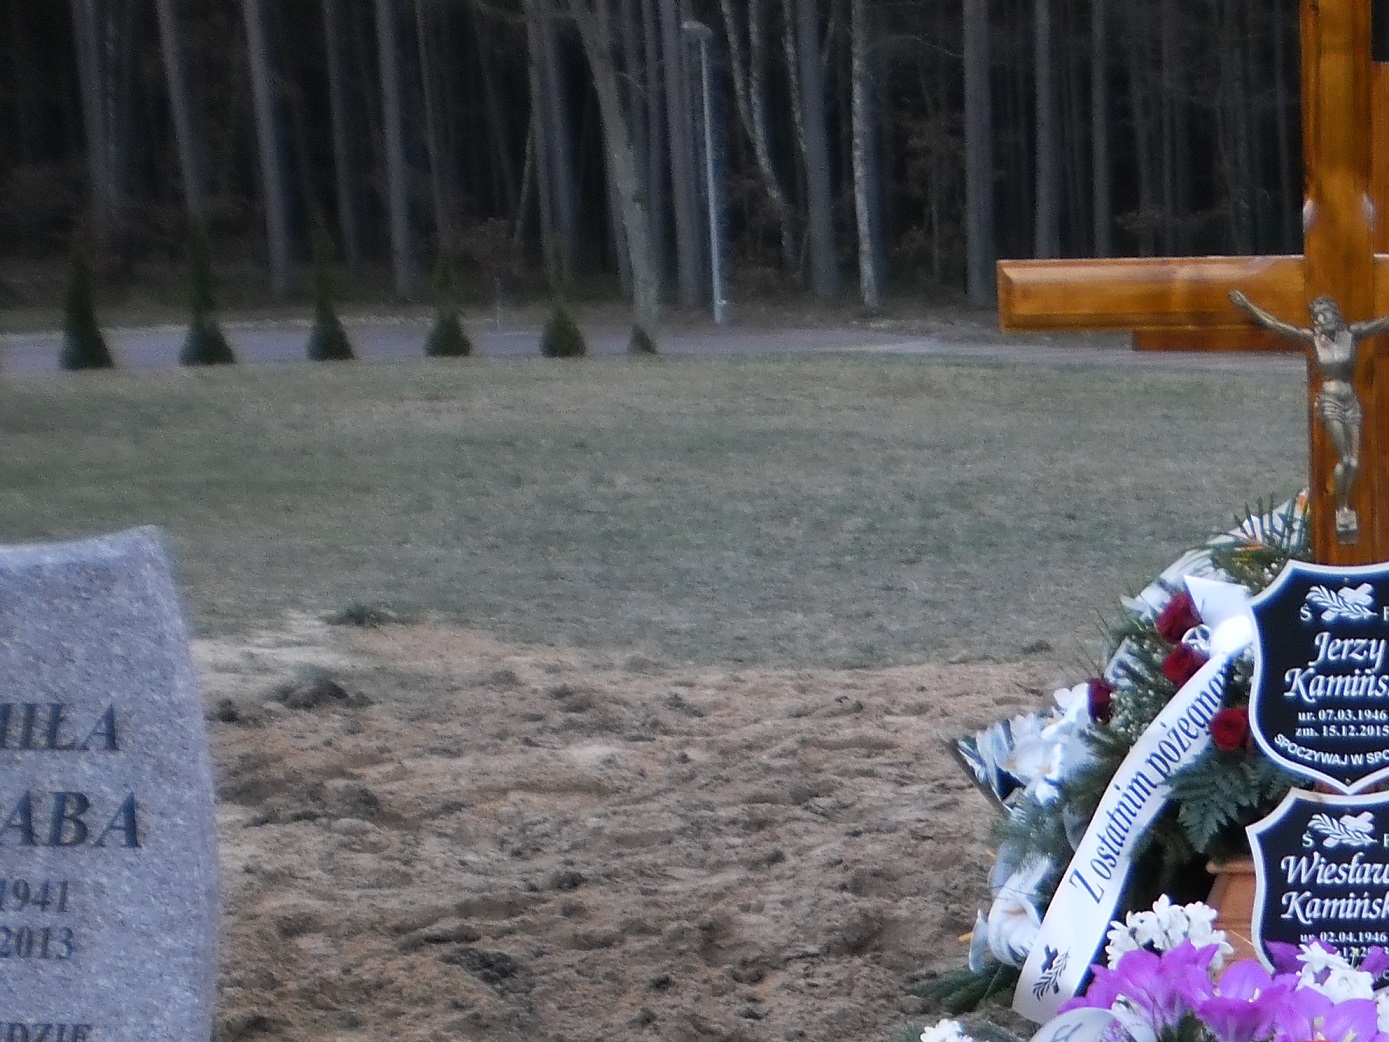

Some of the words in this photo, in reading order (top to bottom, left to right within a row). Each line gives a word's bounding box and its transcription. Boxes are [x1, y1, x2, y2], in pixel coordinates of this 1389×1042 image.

[1308, 631, 1388, 671] Jerzy
[0, 703, 120, 751] IŁA
[1295, 726, 1319, 737] zm.
[1322, 725, 1389, 737] 15.12.2015
[1298, 711, 1317, 722] ur.
[1318, 709, 1387, 722] 07.03.1946
[1274, 733, 1350, 766] SPOCZYWAJ
[1351, 753, 1364, 766] W
[1091, 770, 1158, 879] ostatnim
[1319, 931, 1388, 943] 02.04.1946
